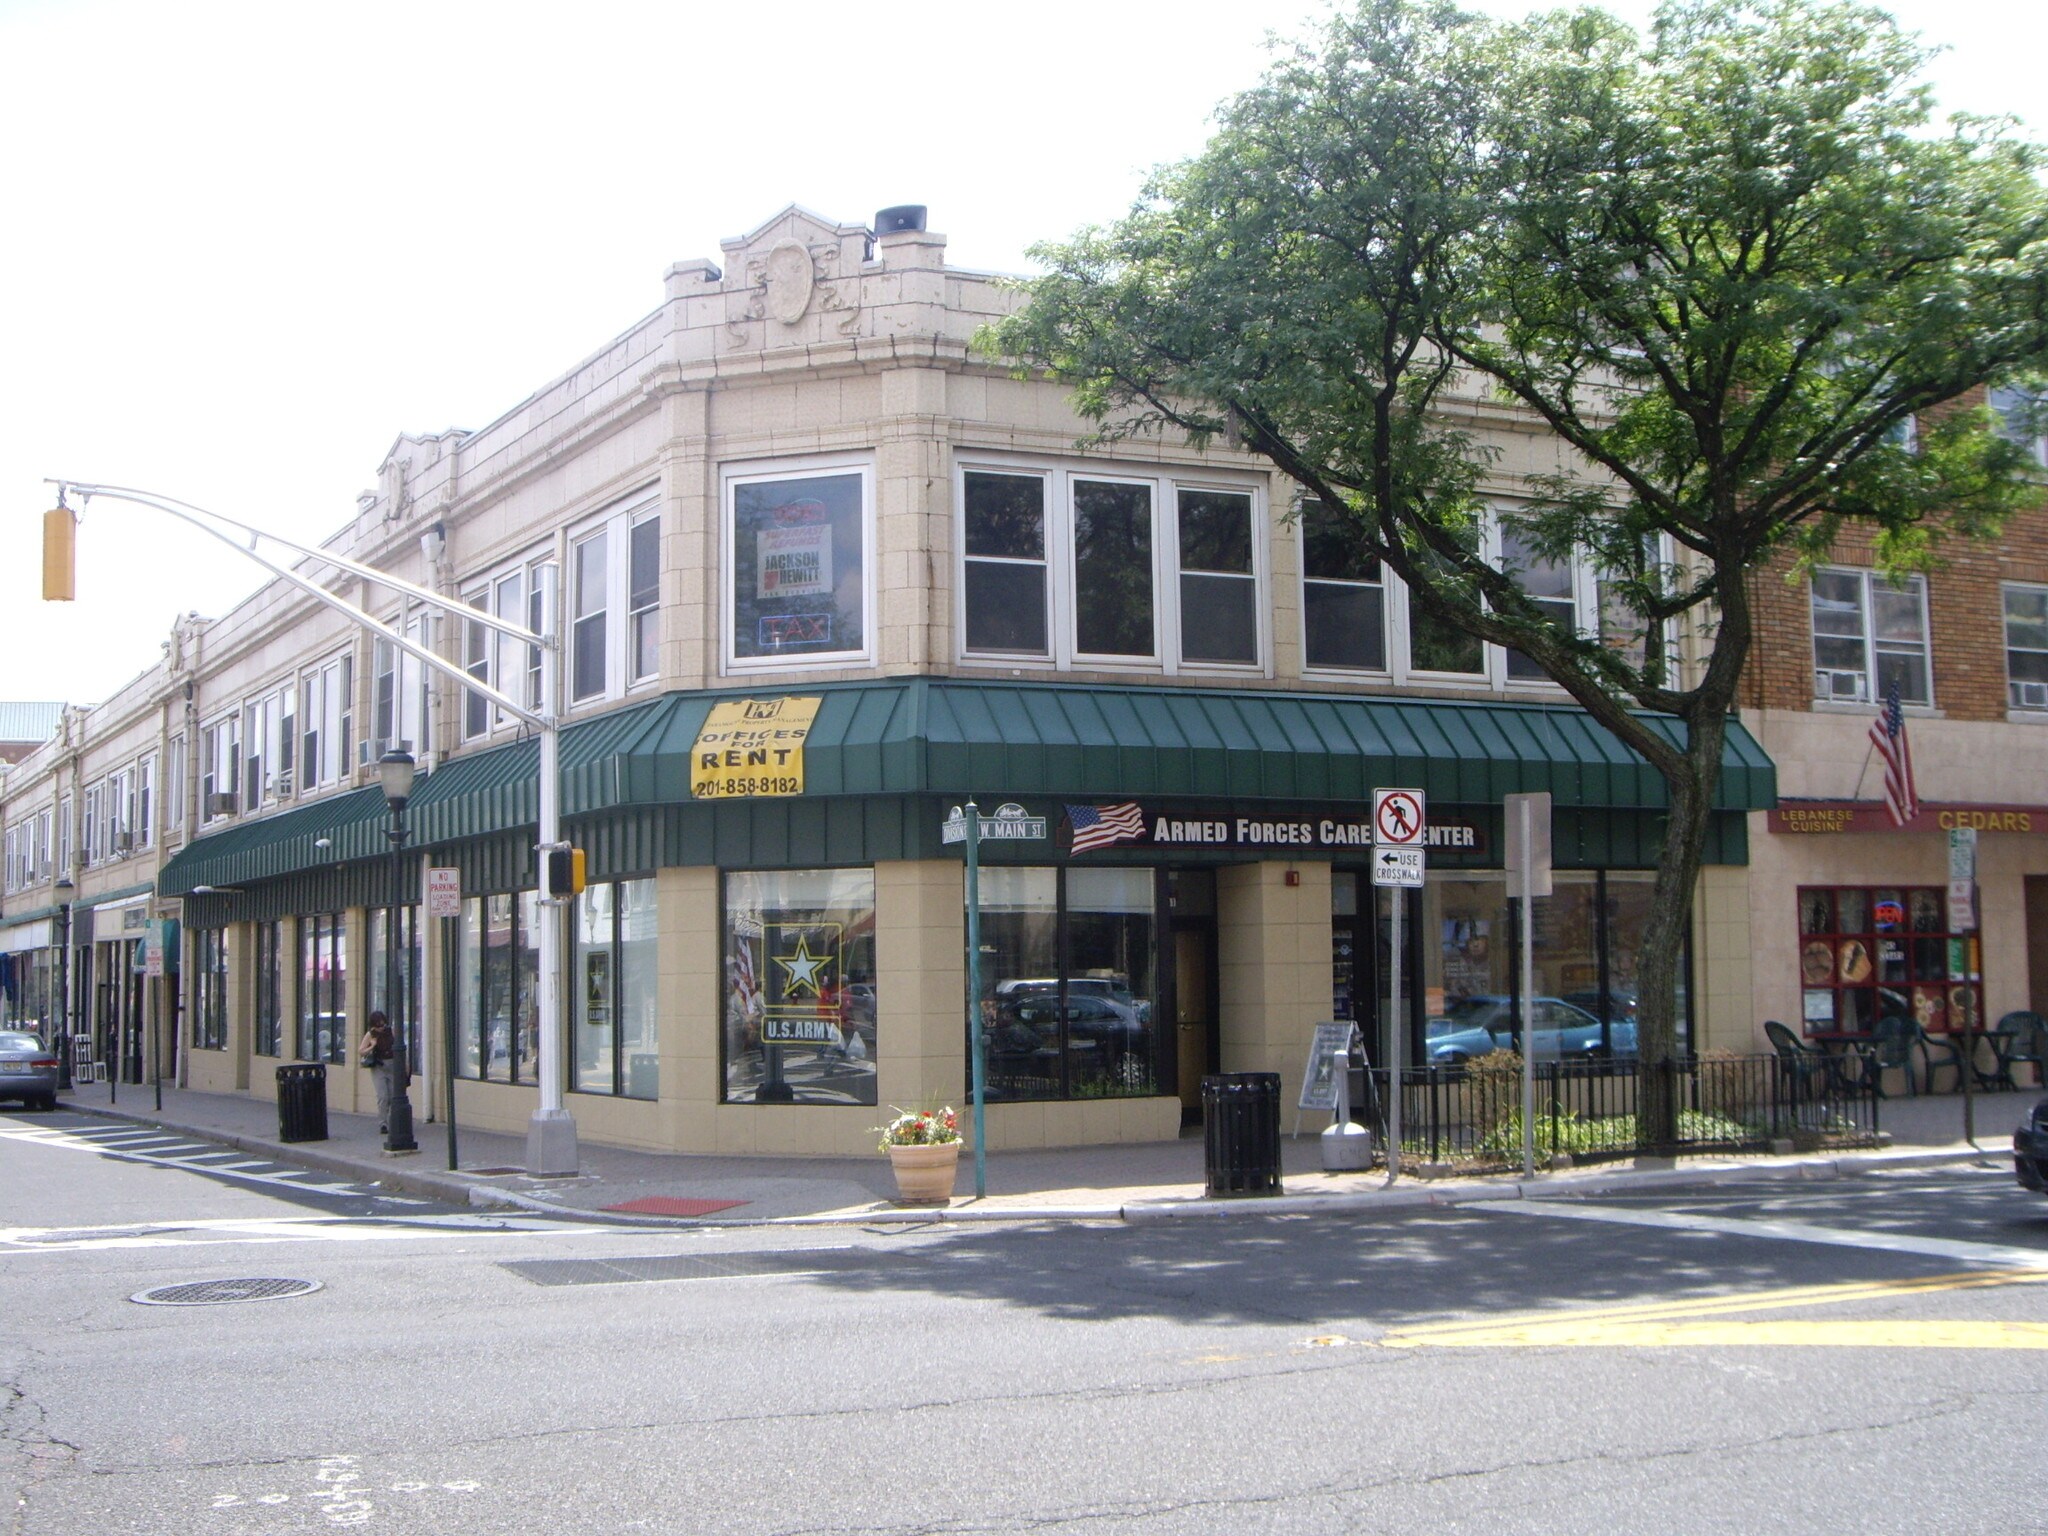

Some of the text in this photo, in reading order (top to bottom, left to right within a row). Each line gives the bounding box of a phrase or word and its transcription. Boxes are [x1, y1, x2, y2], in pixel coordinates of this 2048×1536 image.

[765, 551, 820, 570] JACKSON
[780, 567, 819, 584] HEWITT
[764, 615, 825, 641] TAX
[701, 729, 806, 743] OFFICES
[731, 740, 765, 748] FOR
[701, 748, 791, 770] RENT
[697, 777, 798, 796] 201-858-8182
[1781, 810, 1853, 821] LEBANESE
[1938, 811, 2031, 832] CEDARS
[981, 823, 1041, 837] W. MAIN ST
[1154, 817, 1474, 846] ARMED FORCES CARE ENTER
[1791, 821, 1844, 832] CUISINE
[1400, 855, 1418, 866] USE
[439, 873, 448, 881] NO
[1376, 868, 1421, 881] CROSSWALK
[431, 883, 458, 892] PARKING
